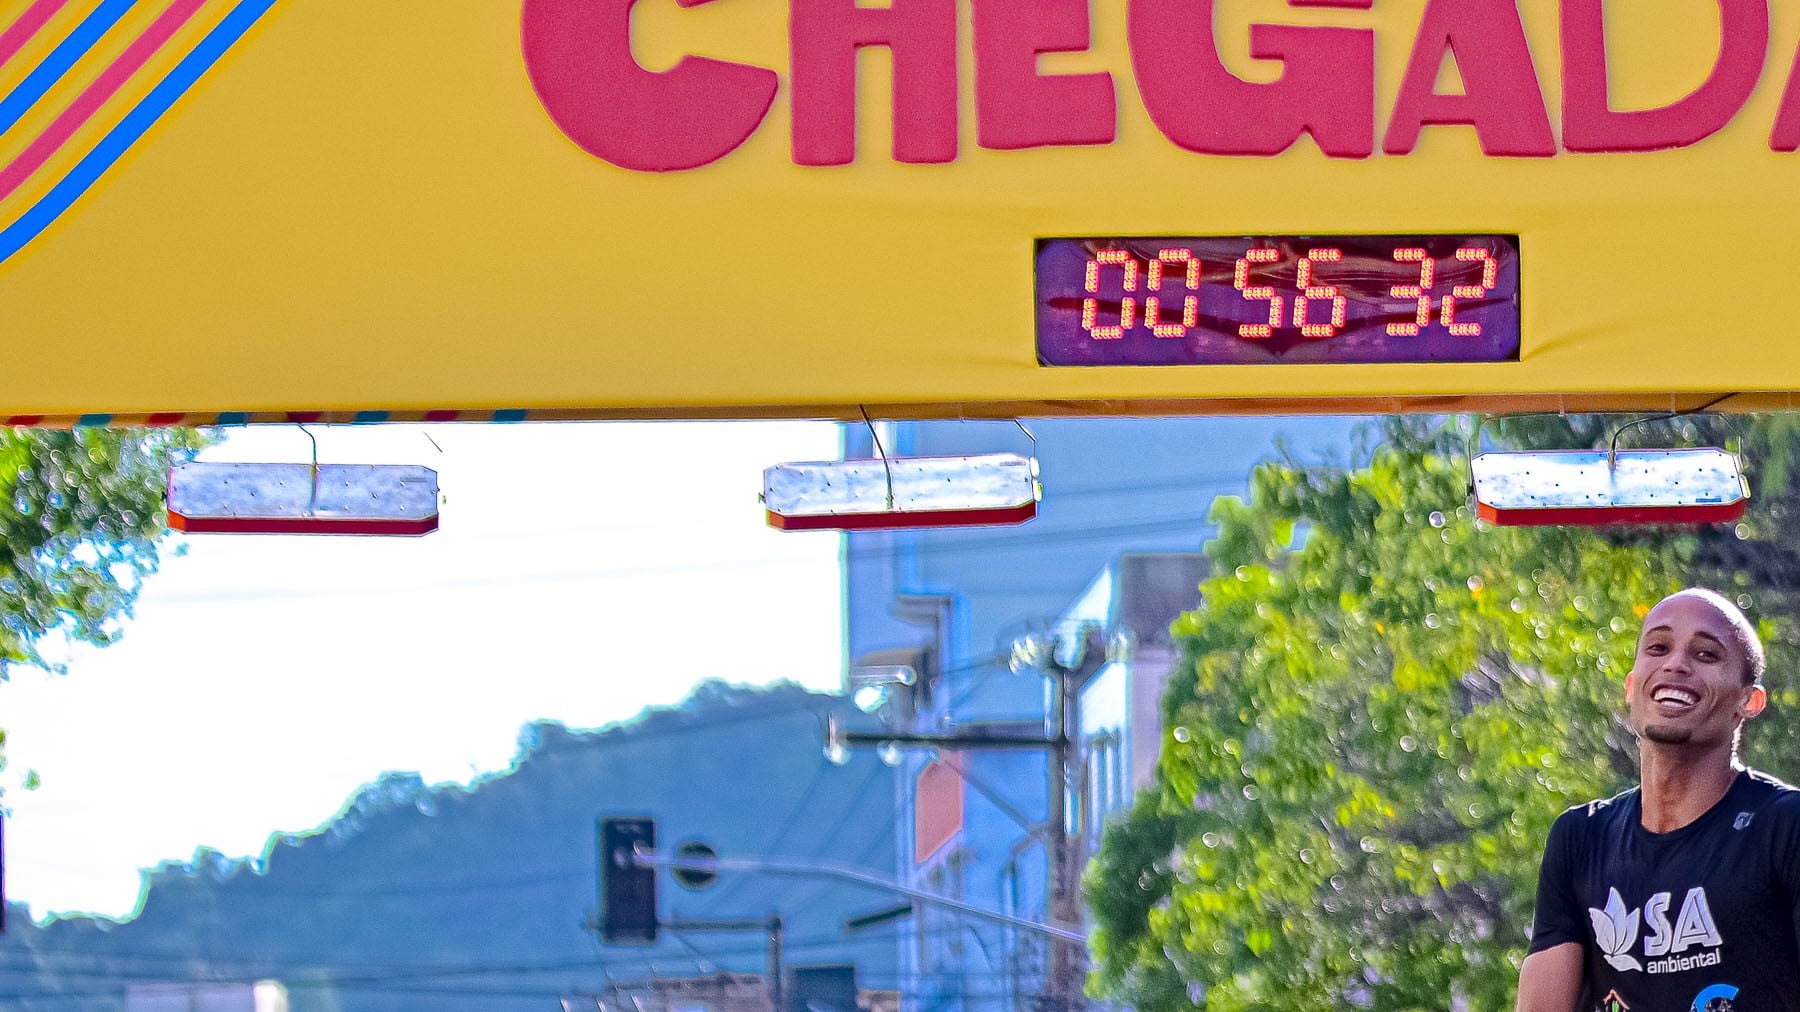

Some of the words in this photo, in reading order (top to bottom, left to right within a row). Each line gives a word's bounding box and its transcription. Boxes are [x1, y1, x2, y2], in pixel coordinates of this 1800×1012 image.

[1080, 247, 1201, 340] 00
[1233, 247, 1347, 338] 56
[1385, 247, 1498, 337] 32
[1644, 886, 1723, 957] SA
[1647, 948, 1722, 975] ambiental
